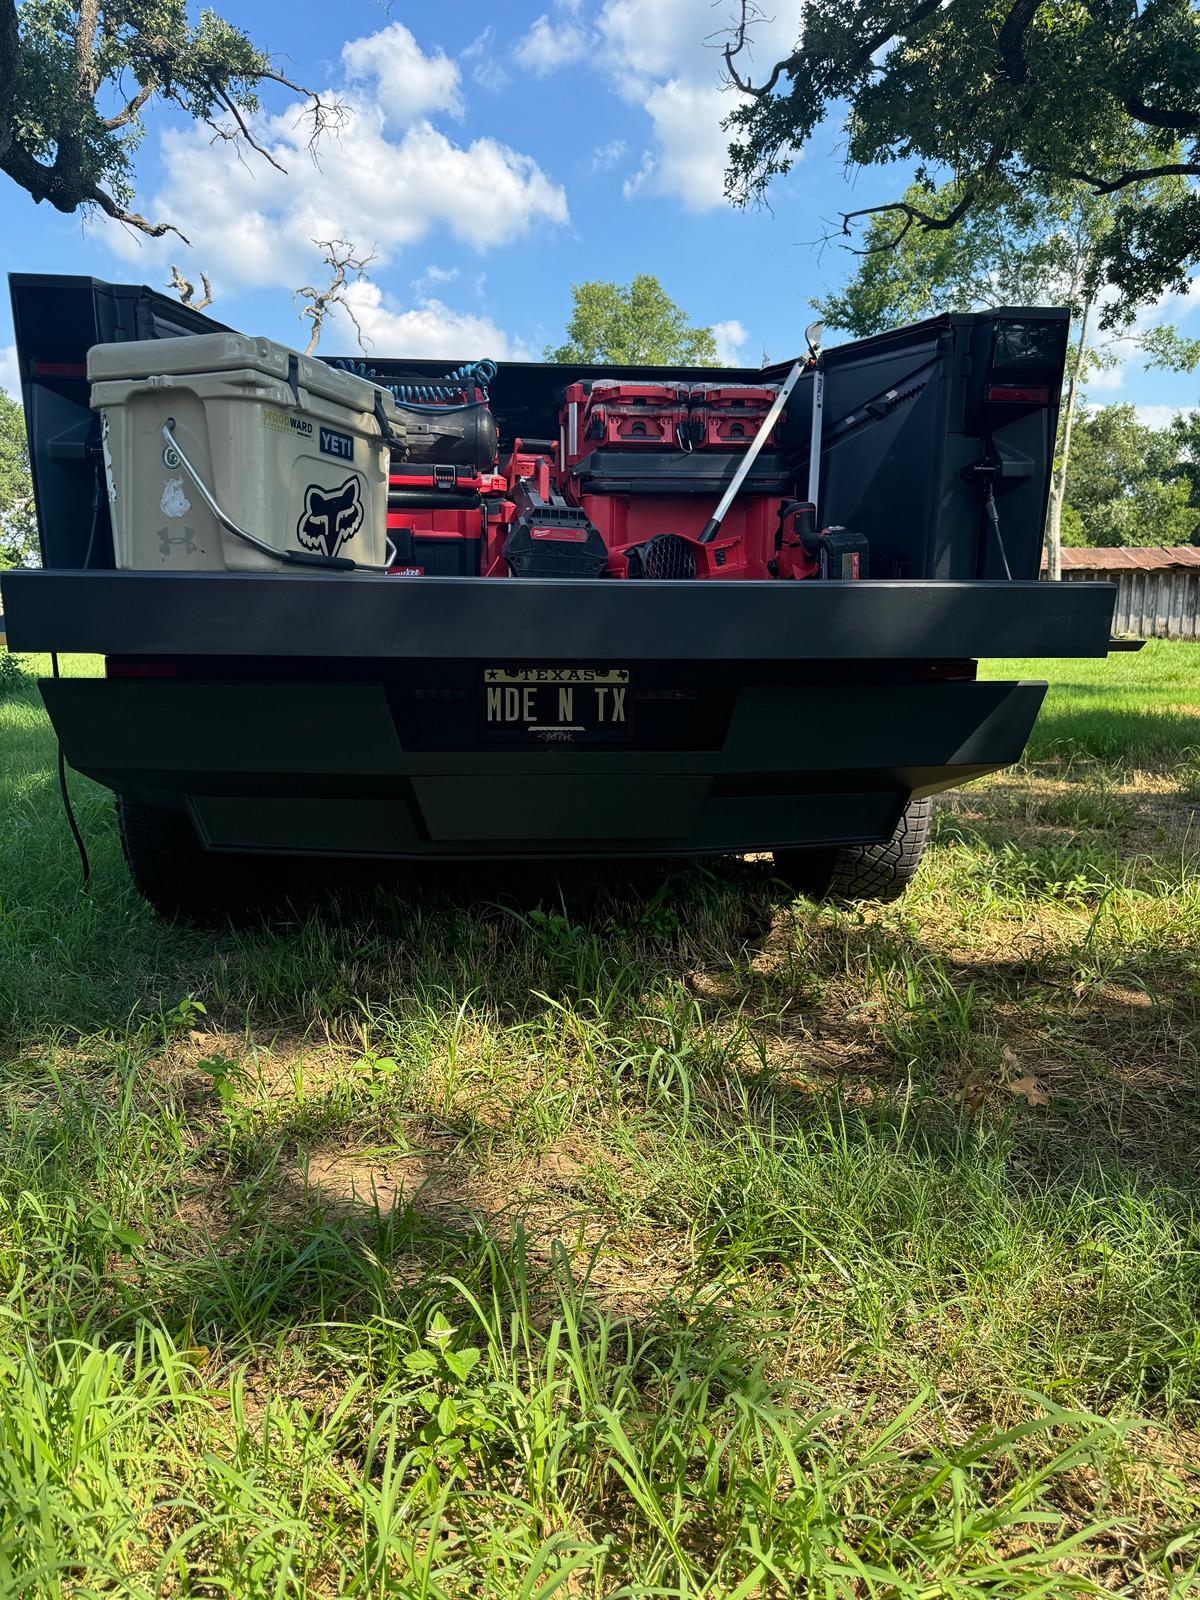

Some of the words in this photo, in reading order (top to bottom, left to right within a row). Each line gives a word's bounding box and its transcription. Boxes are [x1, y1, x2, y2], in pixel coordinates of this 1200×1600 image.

[321, 431, 352, 457] YETI
[519, 669, 596, 681] TEXAS
[487, 687, 538, 722] MDE
[558, 687, 573, 722] N
[594, 687, 626, 722] TX
